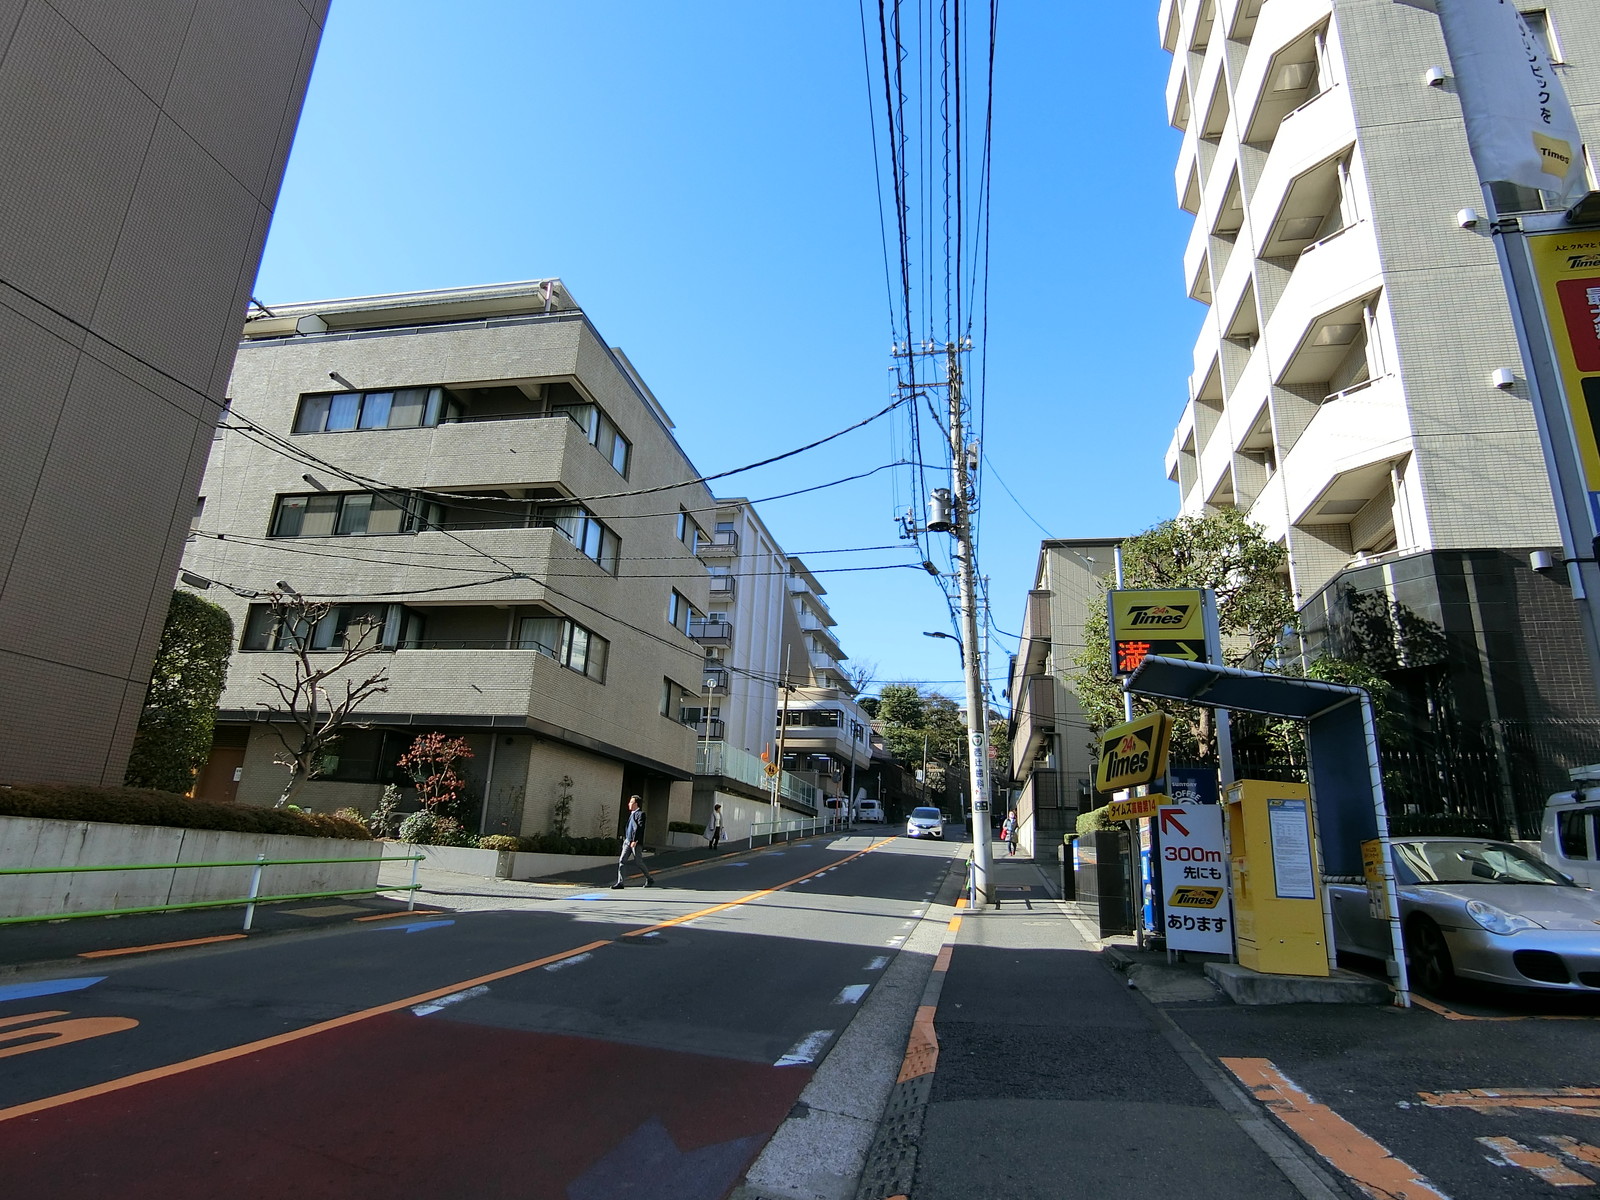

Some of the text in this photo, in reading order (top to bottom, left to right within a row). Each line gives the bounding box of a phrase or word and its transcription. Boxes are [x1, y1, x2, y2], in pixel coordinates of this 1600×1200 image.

[1540, 147, 1570, 165] Times
[1555, 241, 1600, 252] 人とクルマと
[1567, 254, 1600, 269] Time
[1127, 605, 1187, 626] Times
[1117, 641, 1151, 672] 満
[1103, 736, 1150, 782] Times
[1170, 789, 1202, 802] COFFEE
[1165, 846, 1222, 863] 300m
[1184, 866, 1222, 880] 先にも
[1175, 889, 1217, 905] Times
[1167, 914, 1227, 933] あります
